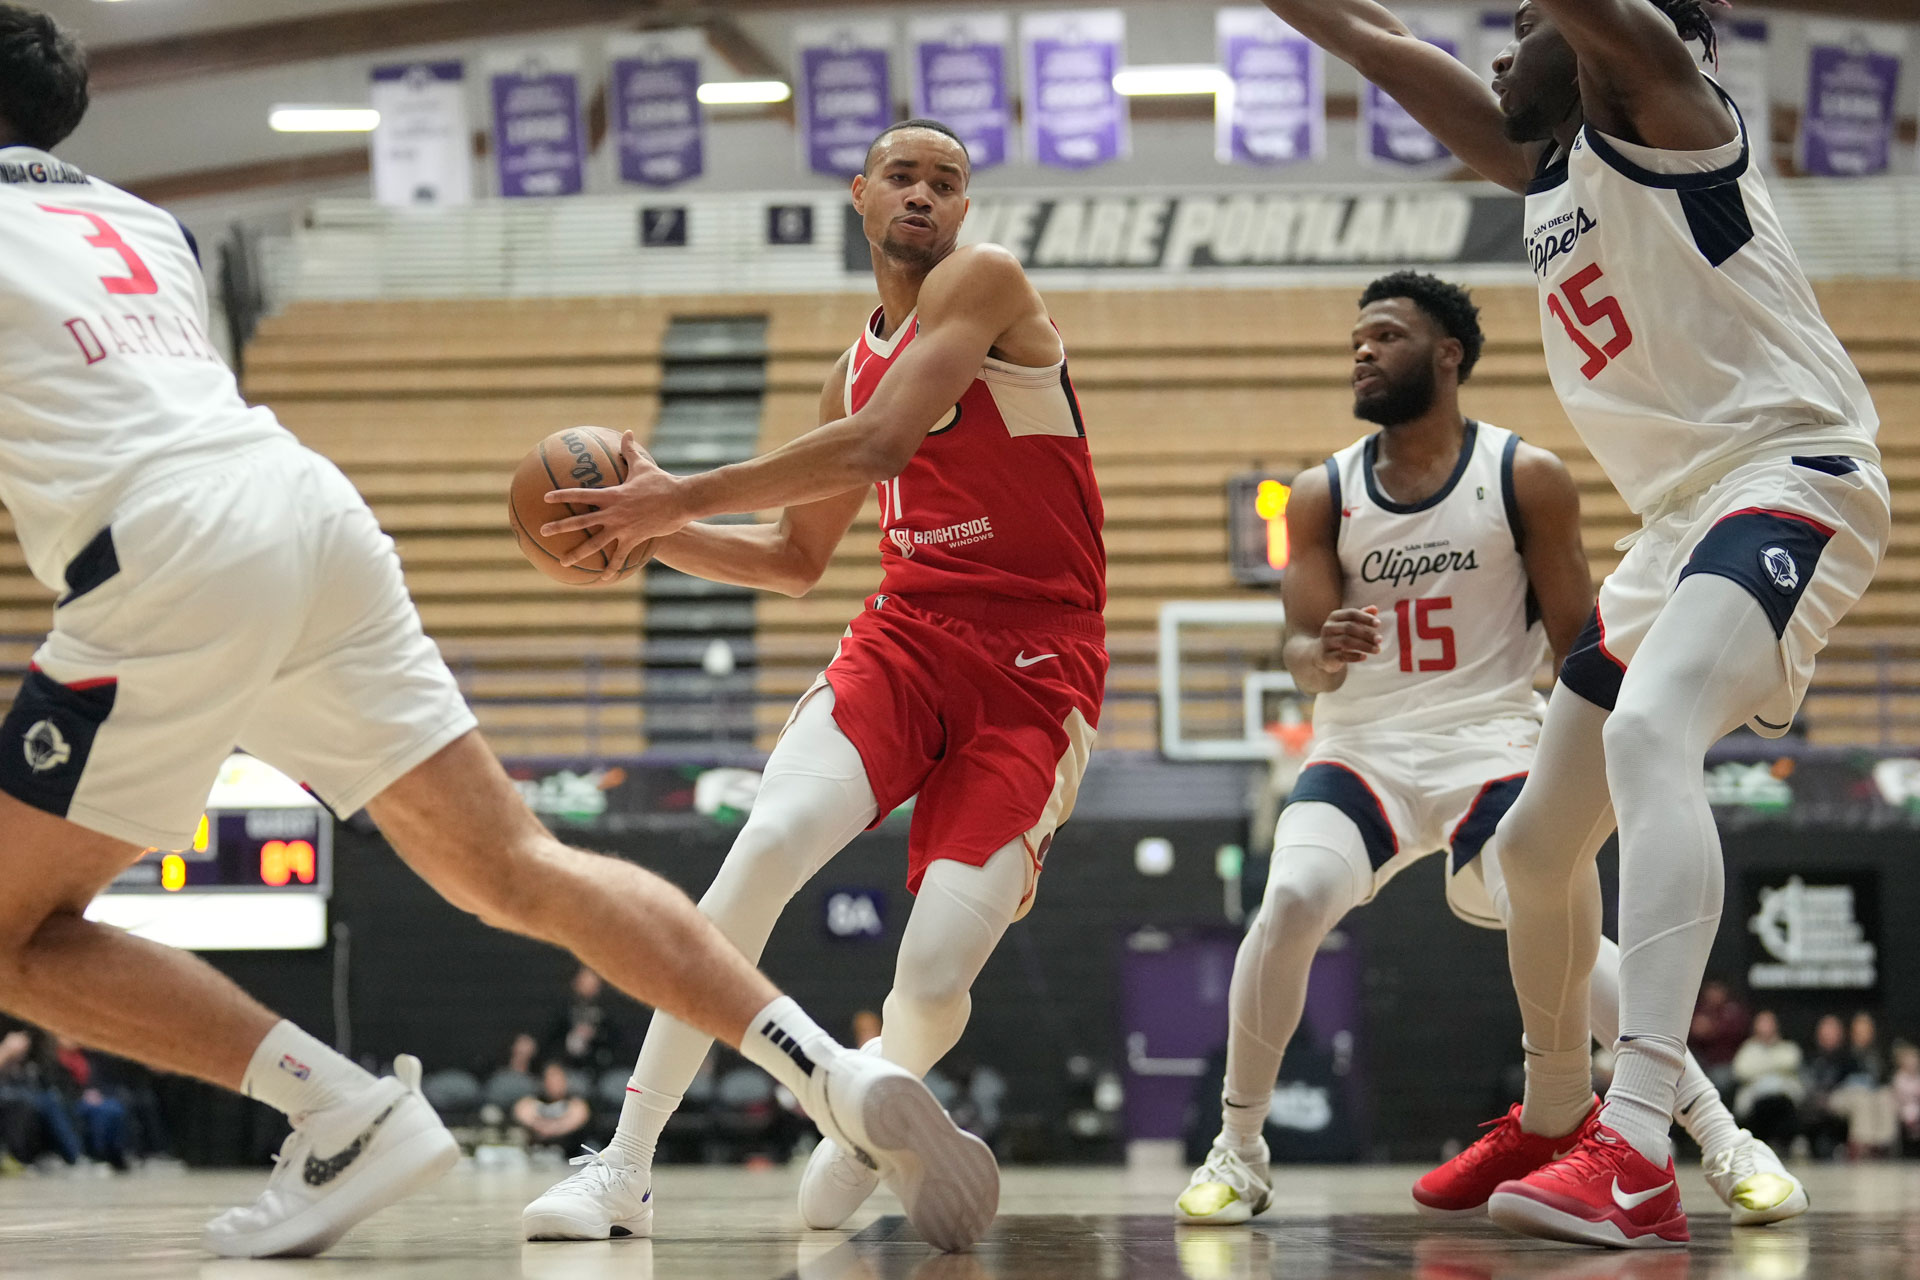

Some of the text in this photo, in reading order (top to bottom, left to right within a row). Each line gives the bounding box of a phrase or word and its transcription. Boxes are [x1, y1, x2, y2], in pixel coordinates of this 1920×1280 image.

[35, 203, 158, 294] 3
[1033, 196, 1177, 266] ARE
[1160, 196, 1474, 271] PORTLAND
[1533, 223, 1547, 238] SAN
[1547, 262, 1633, 381] 15
[914, 516, 992, 545] BRIGHTSIDE
[948, 531, 994, 549] WINDOWS
[1361, 549, 1479, 587] Clippers
[1394, 596, 1457, 673] 15
